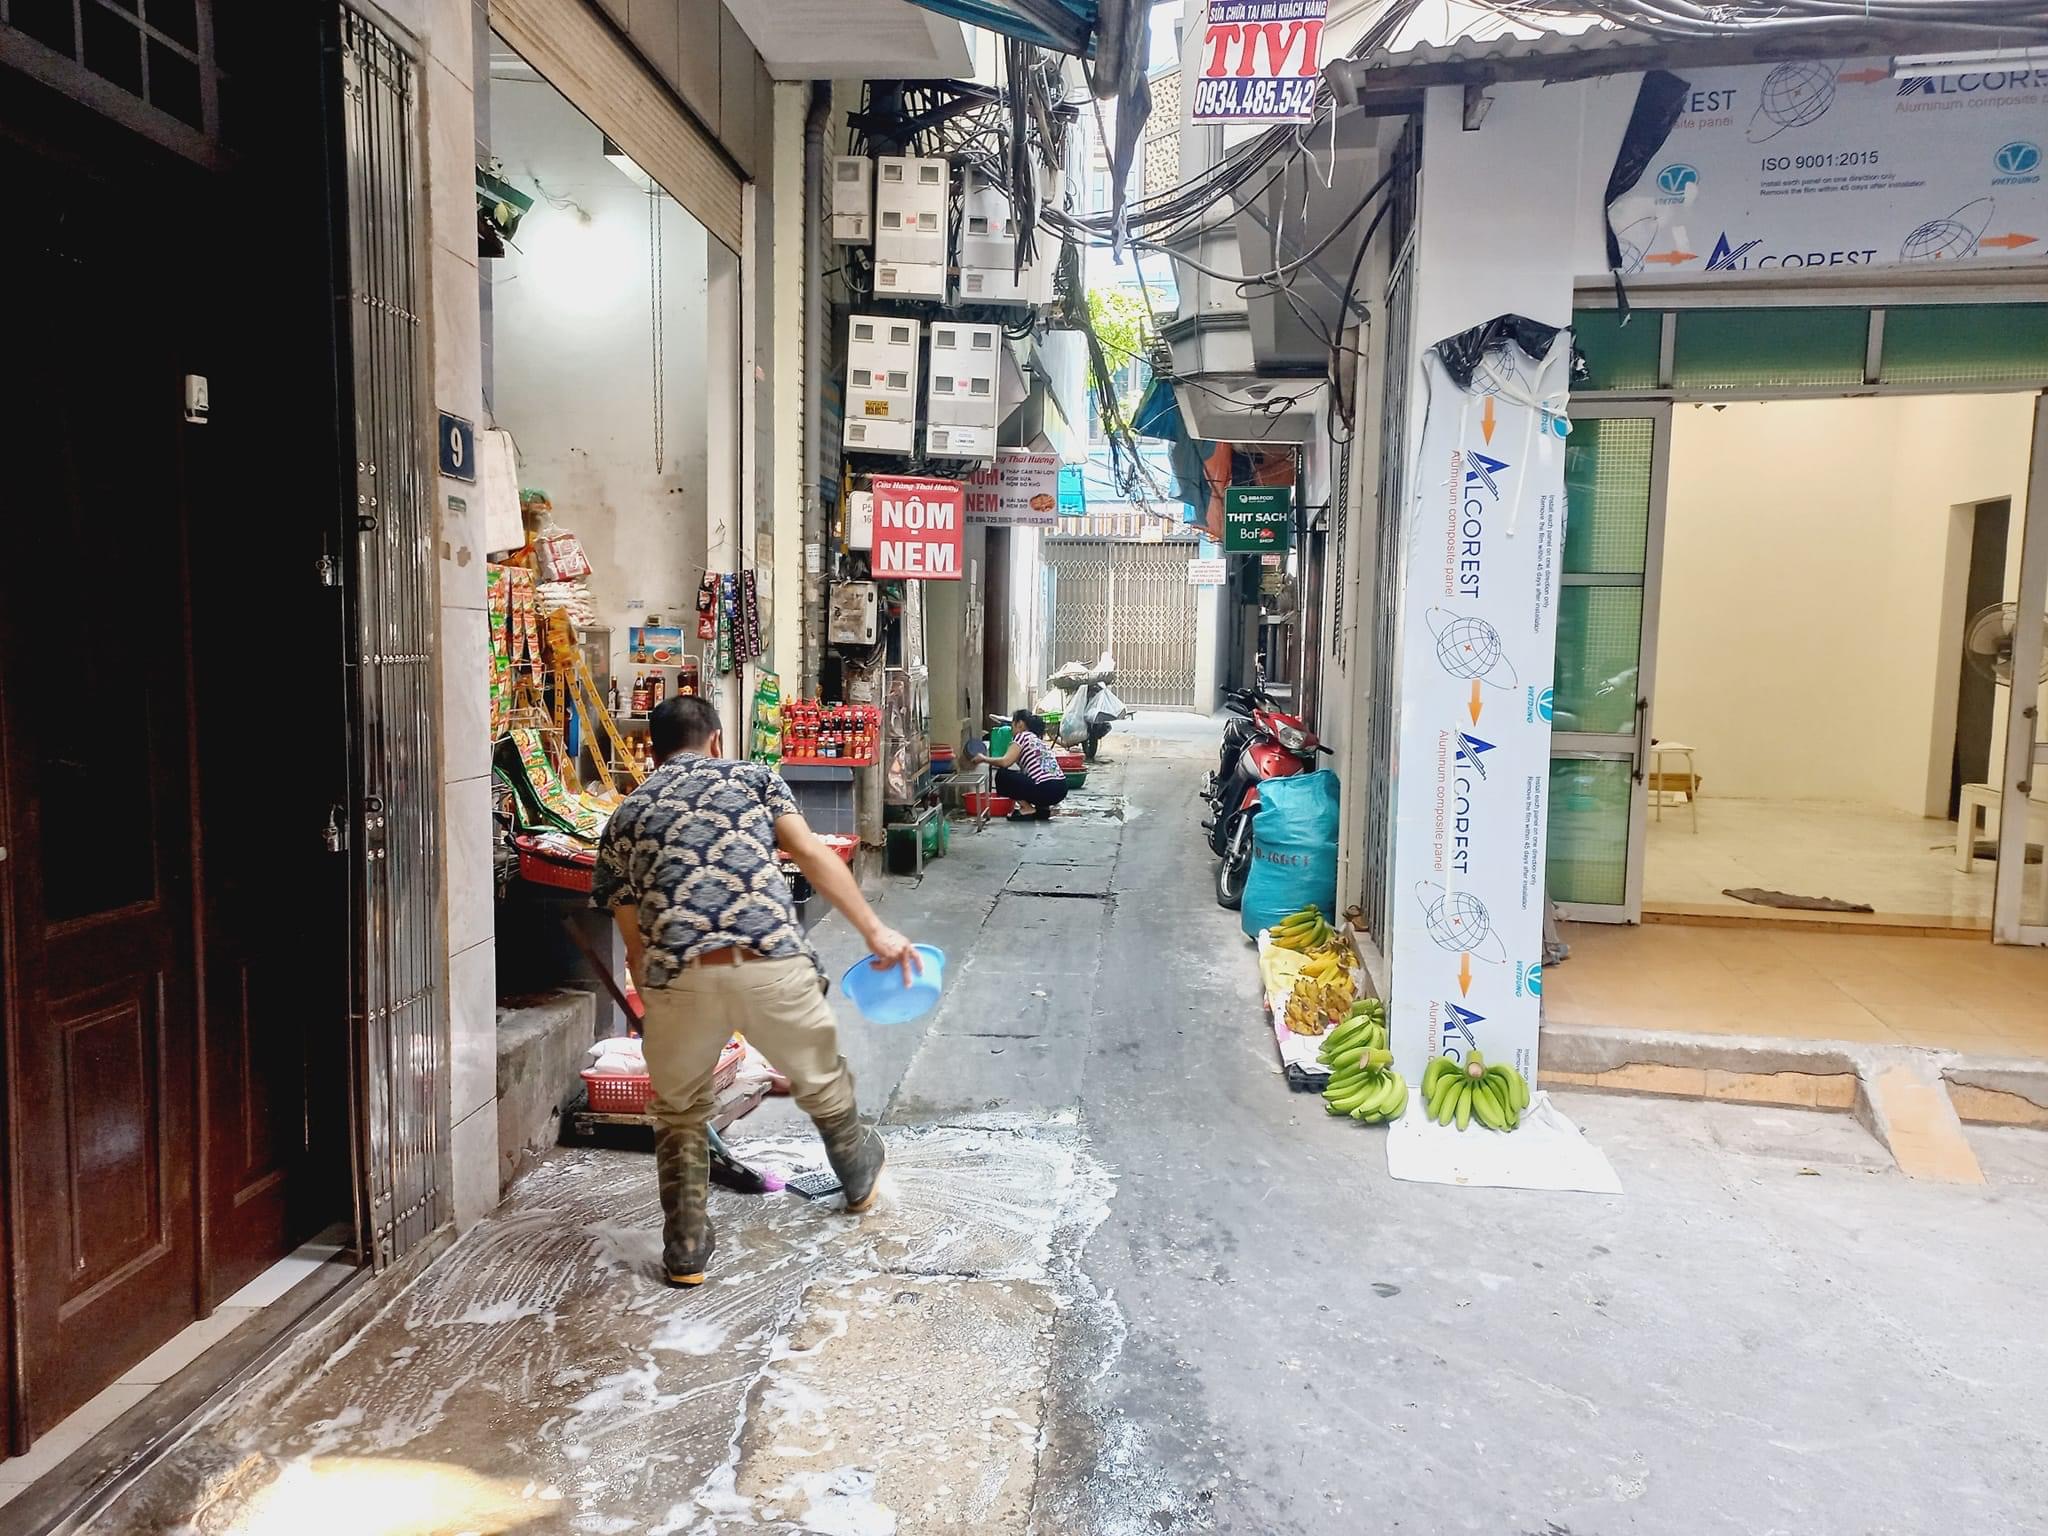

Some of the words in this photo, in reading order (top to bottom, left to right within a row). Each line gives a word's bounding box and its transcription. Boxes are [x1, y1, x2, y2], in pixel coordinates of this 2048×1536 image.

[1261, 3, 1276, 19] NHÀ
[1278, 1, 1302, 18] KHÁCH
[1304, 0, 1326, 16] HÀNG
[1205, 21, 1323, 77] TIVI
[1195, 80, 1315, 115] 0934.485.542
[1896, 101, 1962, 113] Aluminum
[1761, 157, 1790, 171] ISO
[1795, 151, 1879, 168] 9001:2015
[450, 427, 463, 468] 9
[1449, 450, 1460, 505] Aluminum
[881, 496, 954, 535] NỘM
[1227, 513, 1253, 524] THỊT
[1256, 513, 1287, 524] SẠCH
[1460, 450, 1511, 598] ALCOREST
[1241, 528, 1260, 539] BaF
[1445, 509, 1458, 564] composite
[880, 541, 954, 572] NEM
[1445, 568, 1455, 597] panel
[1437, 730, 1449, 783] Aluminum
[1435, 786, 1446, 839] composite
[1533, 827, 1538, 835] on
[1434, 843, 1443, 872] panel
[1428, 1000, 1440, 1052] Aluminum
